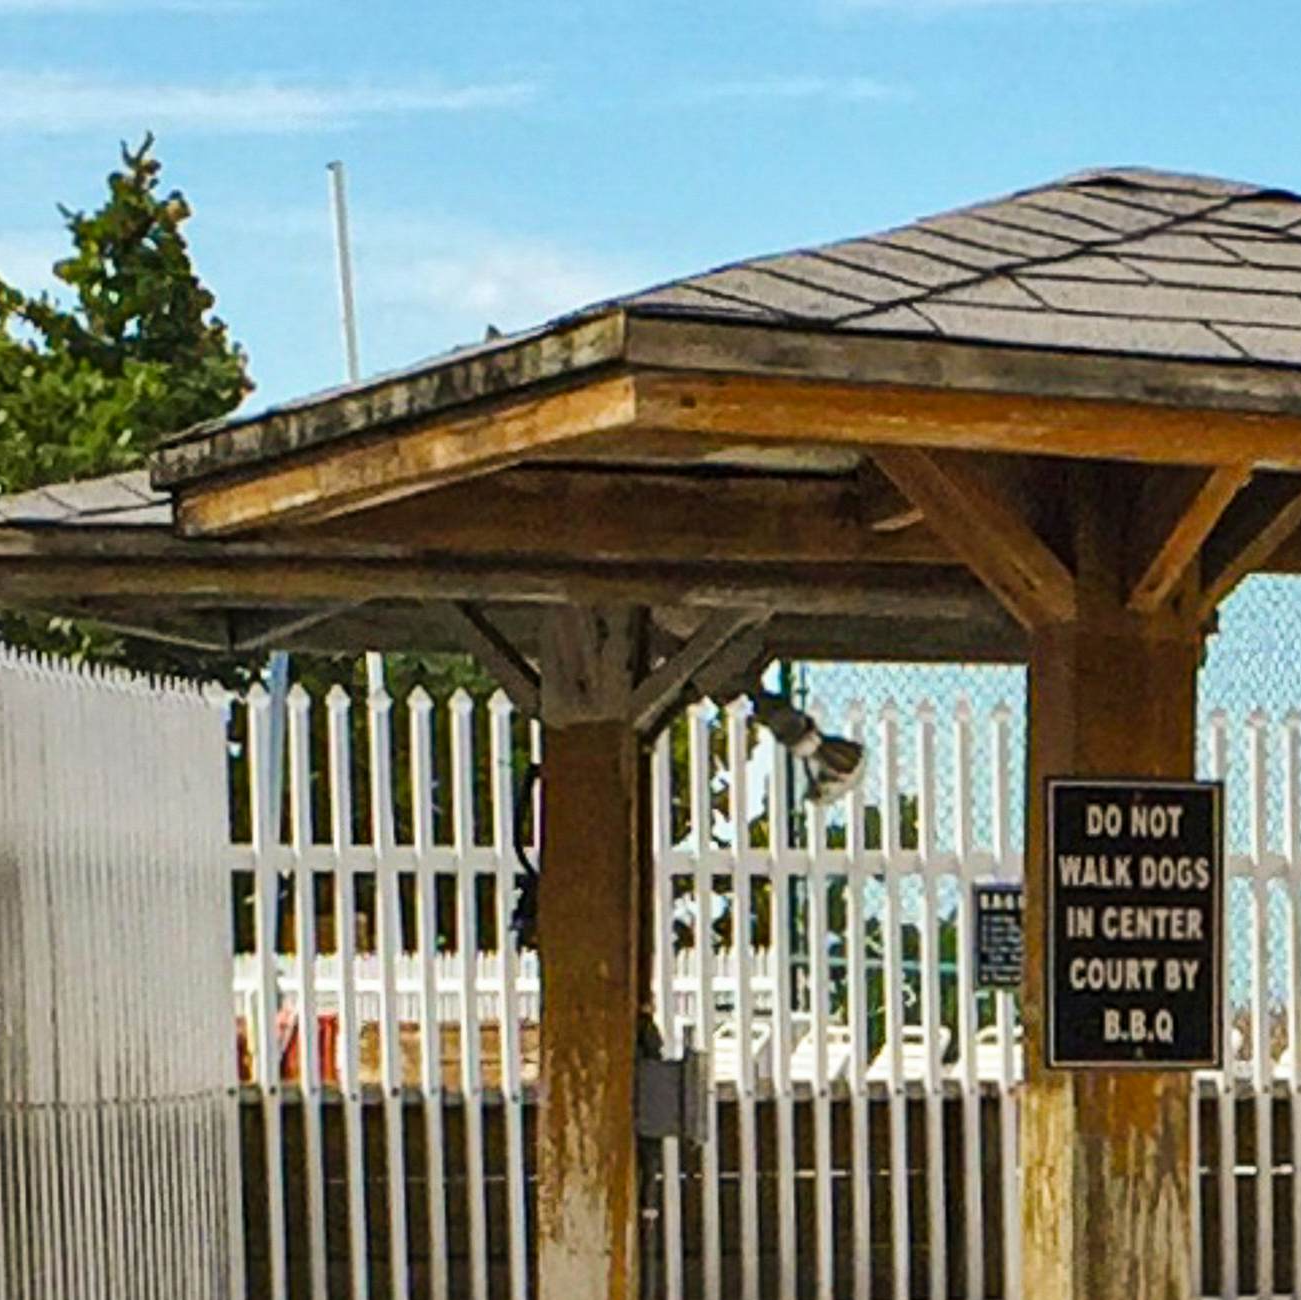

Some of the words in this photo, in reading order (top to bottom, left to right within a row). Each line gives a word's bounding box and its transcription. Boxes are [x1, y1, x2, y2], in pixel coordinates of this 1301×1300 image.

[1085, 804, 1122, 838] DO
[1130, 805, 1183, 839] NOT
[1058, 855, 1132, 888] WALK
[1139, 855, 1209, 890] DOGS
[1067, 906, 1093, 938] IN
[1101, 906, 1203, 940] CENTER
[1069, 957, 1158, 990] COURT
[1164, 959, 1199, 991] BY
